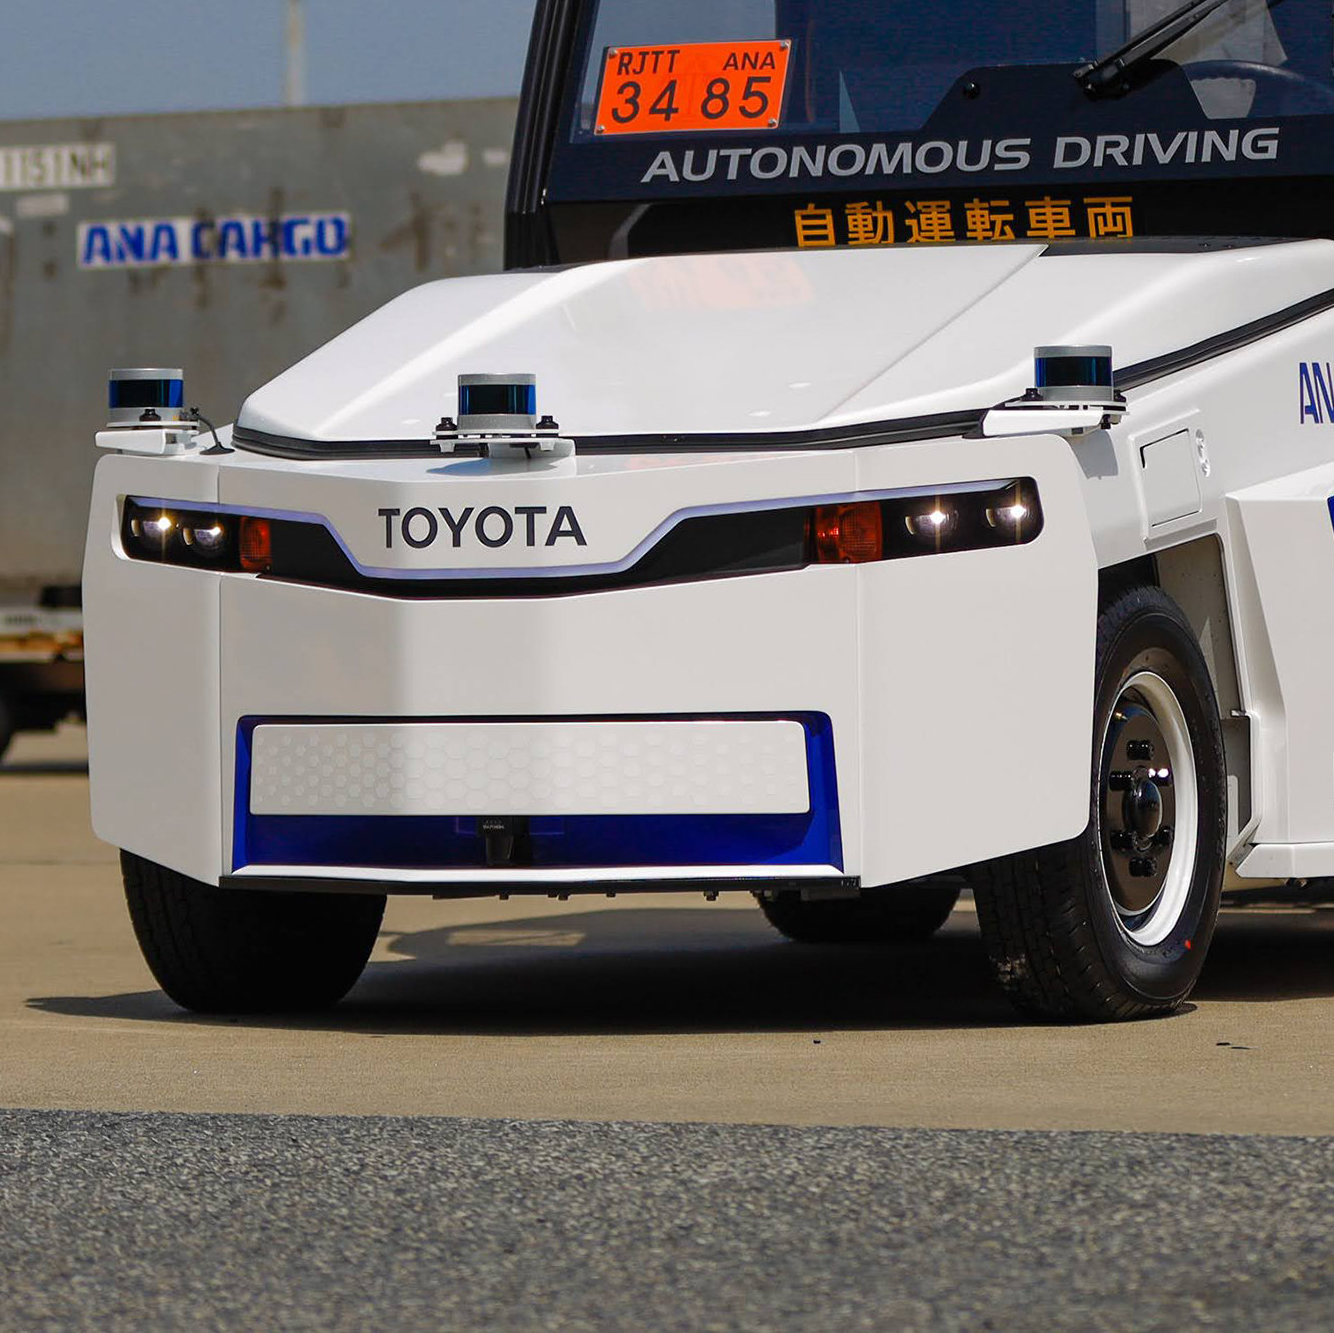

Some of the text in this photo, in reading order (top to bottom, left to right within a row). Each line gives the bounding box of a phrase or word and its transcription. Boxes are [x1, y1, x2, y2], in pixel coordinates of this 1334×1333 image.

[617, 50, 775, 75] RJTT ANA
[611, 76, 771, 123] 34 85
[640, 127, 1280, 183] AUTONOMOUS DRIVING
[84, 217, 337, 264] ANA CARGO
[794, 196, 1133, 248] 自動運転車両
[378, 505, 588, 549] TOYOTA
